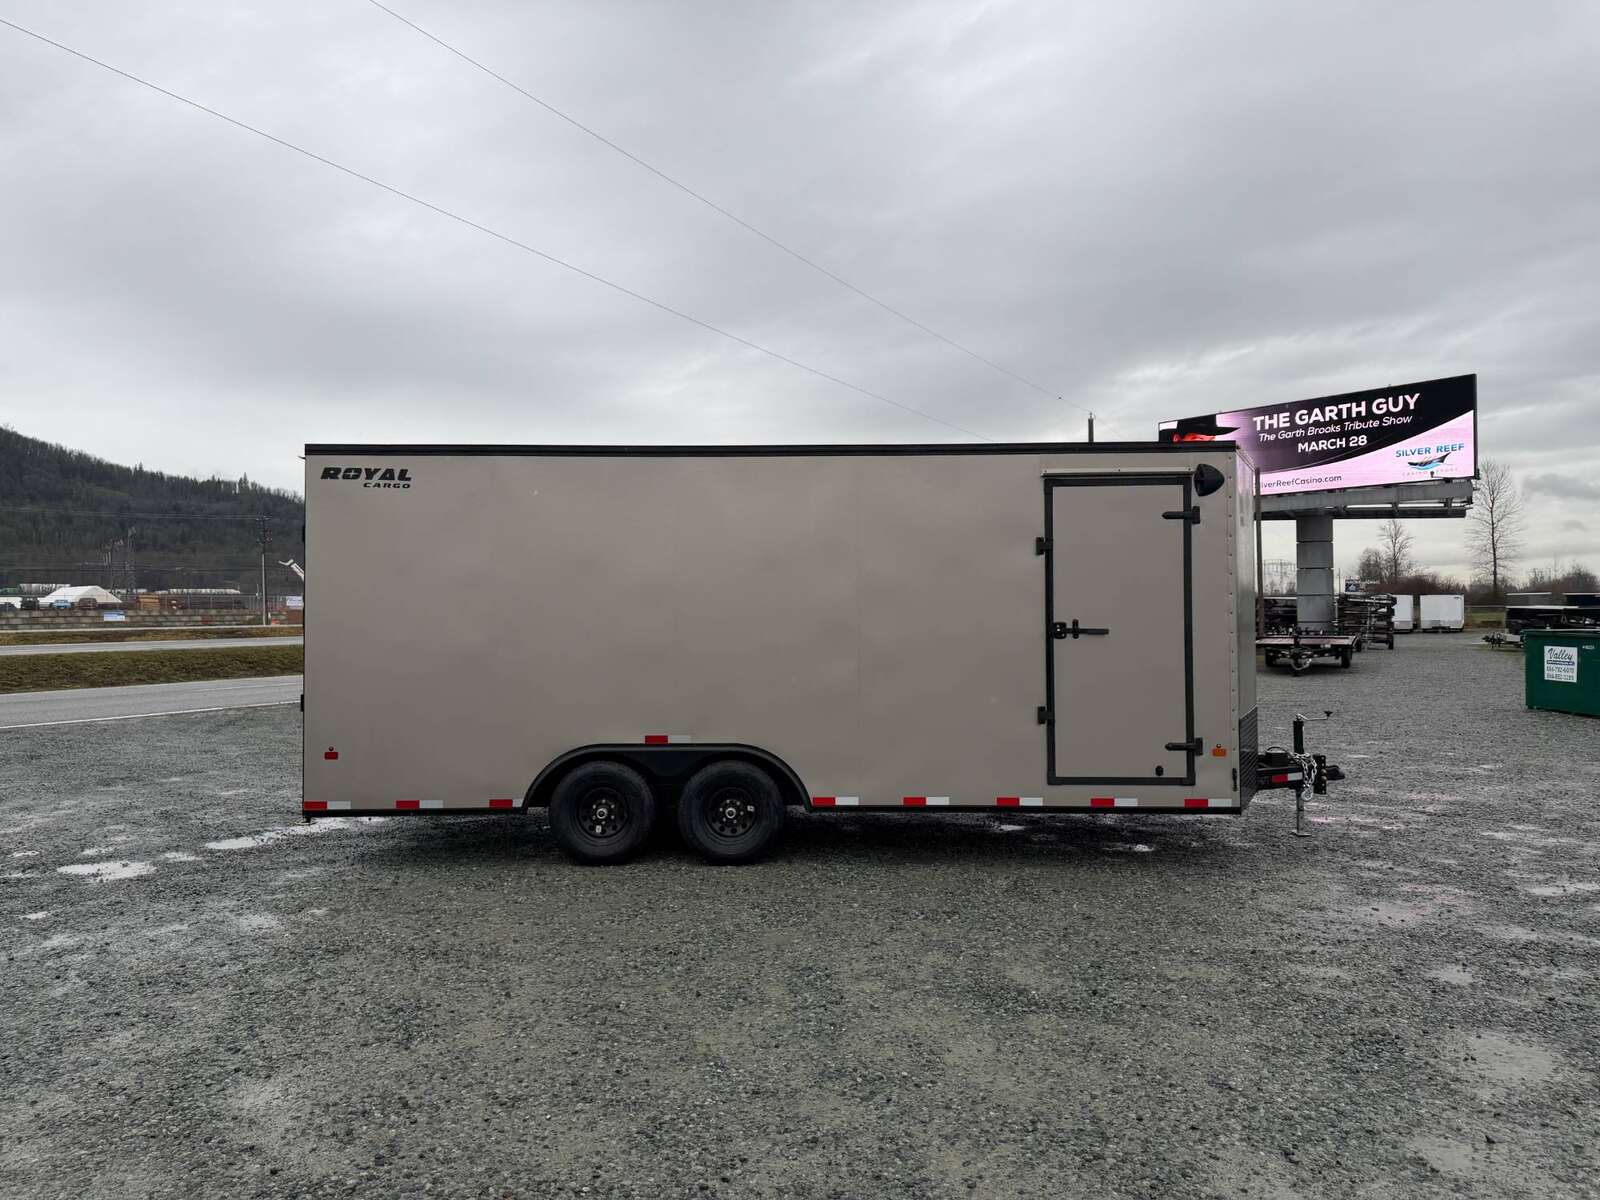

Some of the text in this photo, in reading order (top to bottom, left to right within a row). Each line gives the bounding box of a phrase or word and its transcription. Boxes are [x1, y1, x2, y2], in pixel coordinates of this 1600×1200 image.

[1252, 393, 1420, 431] THE GARTH GUY
[1259, 415, 1413, 442] The Garth Brooks Tribute Show
[1298, 435, 1368, 453] MARCH 28
[1396, 443, 1465, 457] SILVER REEF
[320, 466, 412, 481] ROYAL
[1548, 648, 1573, 660] Valley
